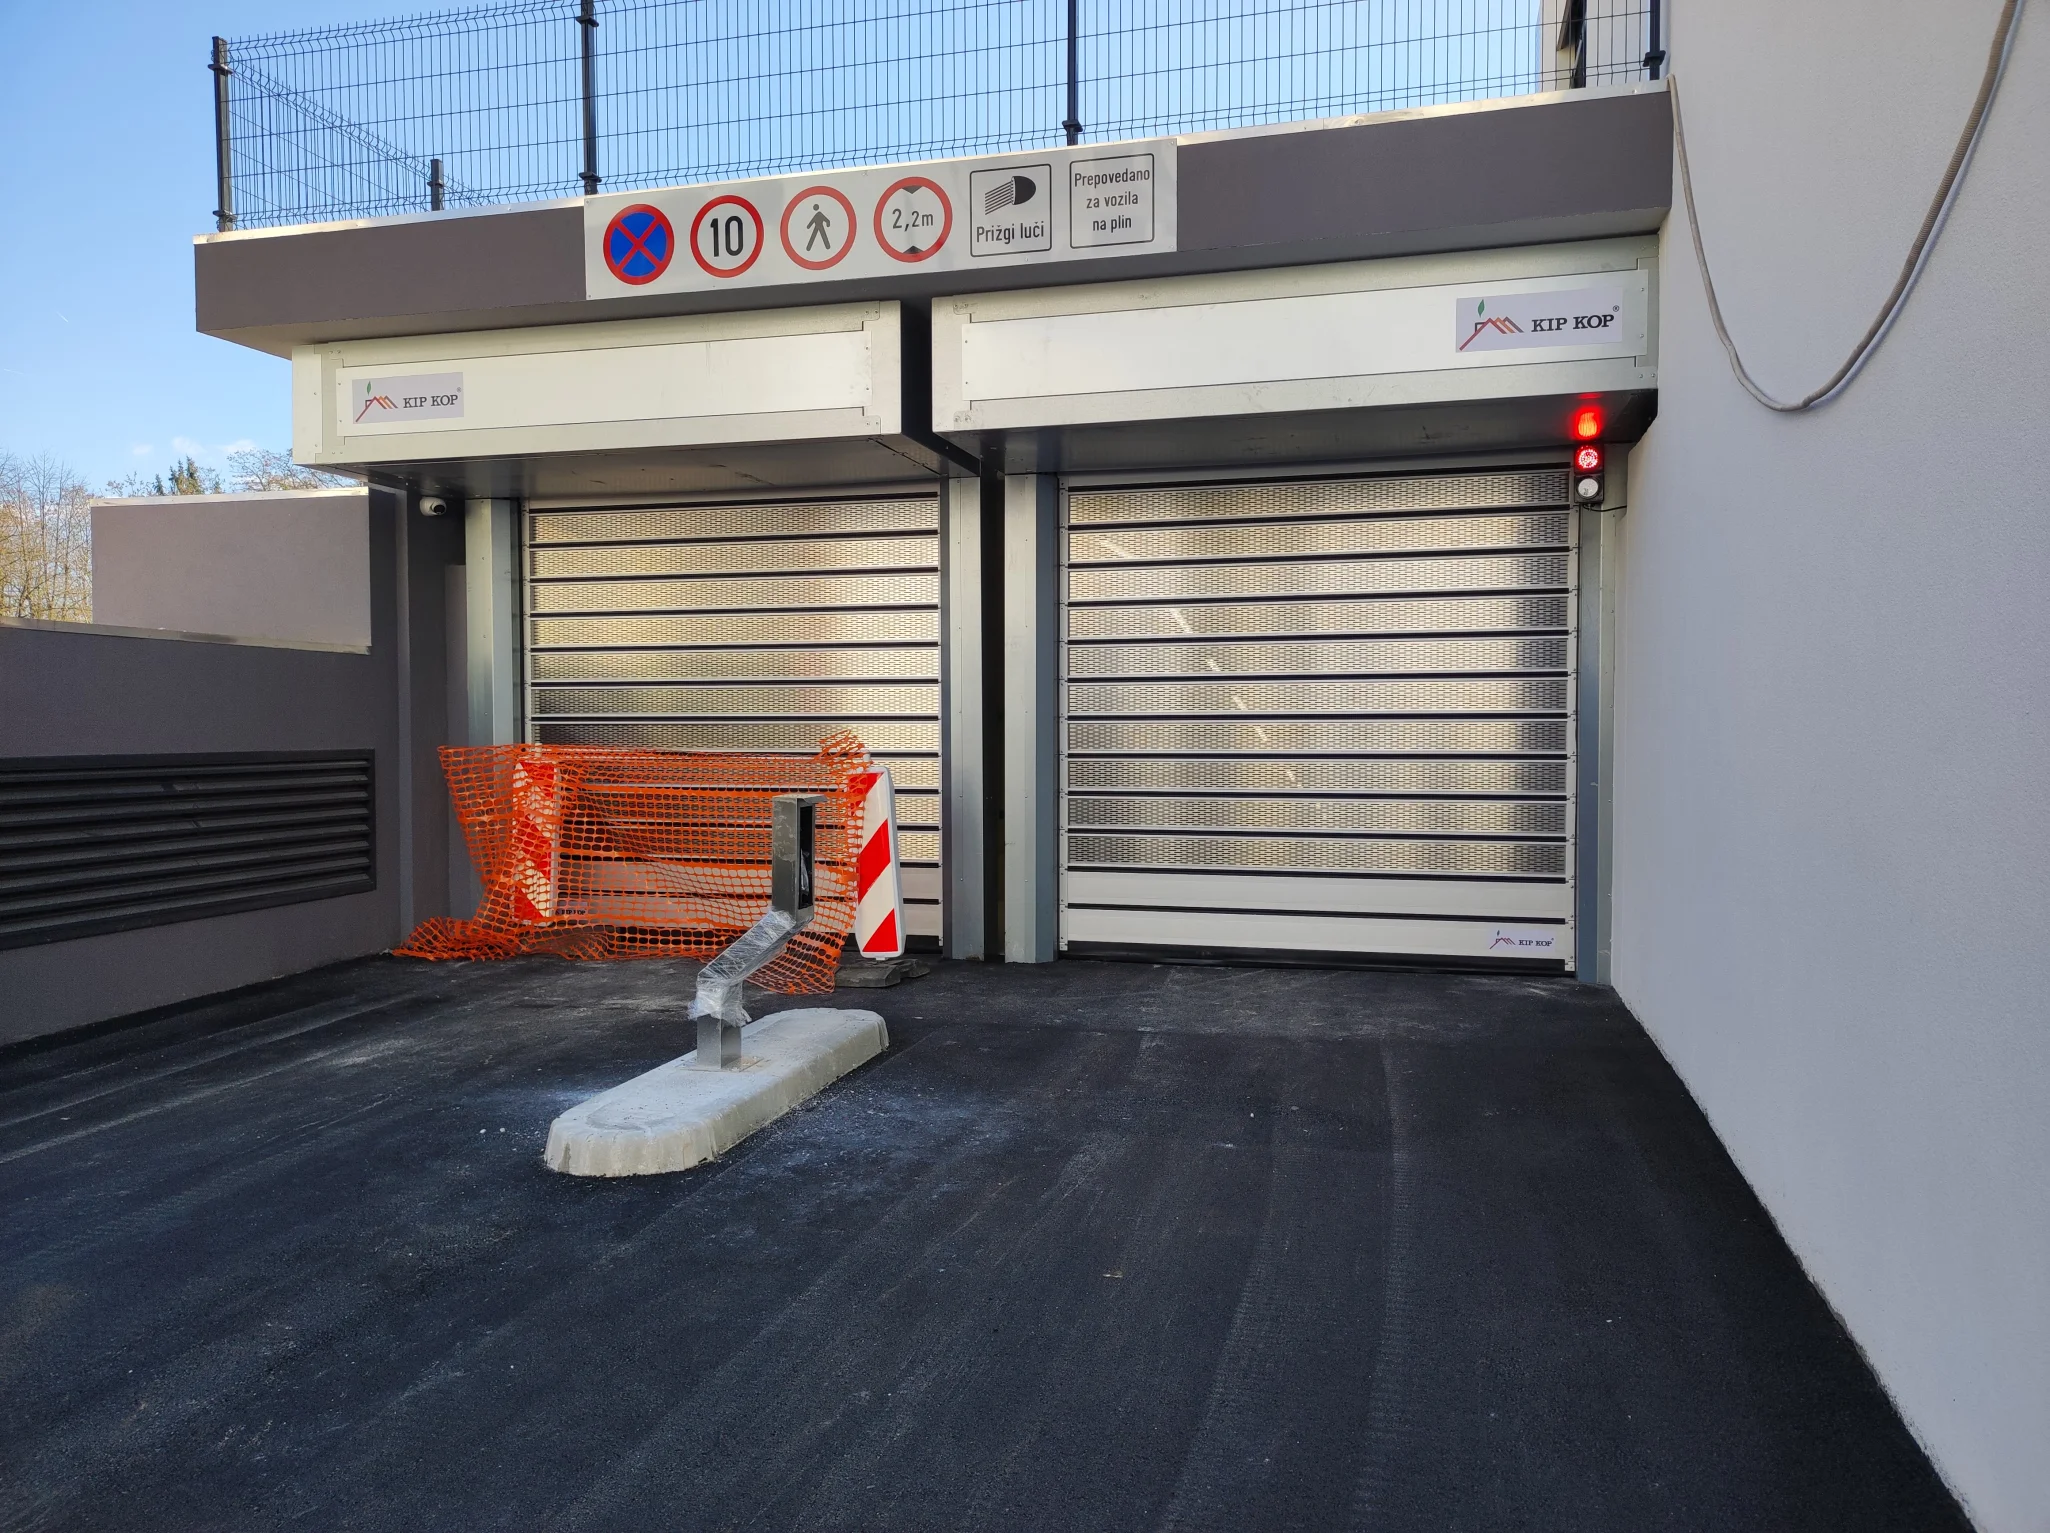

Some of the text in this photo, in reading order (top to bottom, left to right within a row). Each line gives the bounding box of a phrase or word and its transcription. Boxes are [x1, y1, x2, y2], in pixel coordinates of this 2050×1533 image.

[1074, 168, 1150, 189] Prepovedano
[1086, 191, 1139, 209] za vozila
[892, 208, 934, 231] 2,2m
[1092, 214, 1132, 233] na plin
[710, 215, 744, 257] 10
[976, 220, 1044, 245] Prižgi luči
[1531, 314, 1615, 332] KIP KOP
[403, 394, 458, 408] KIP KOP
